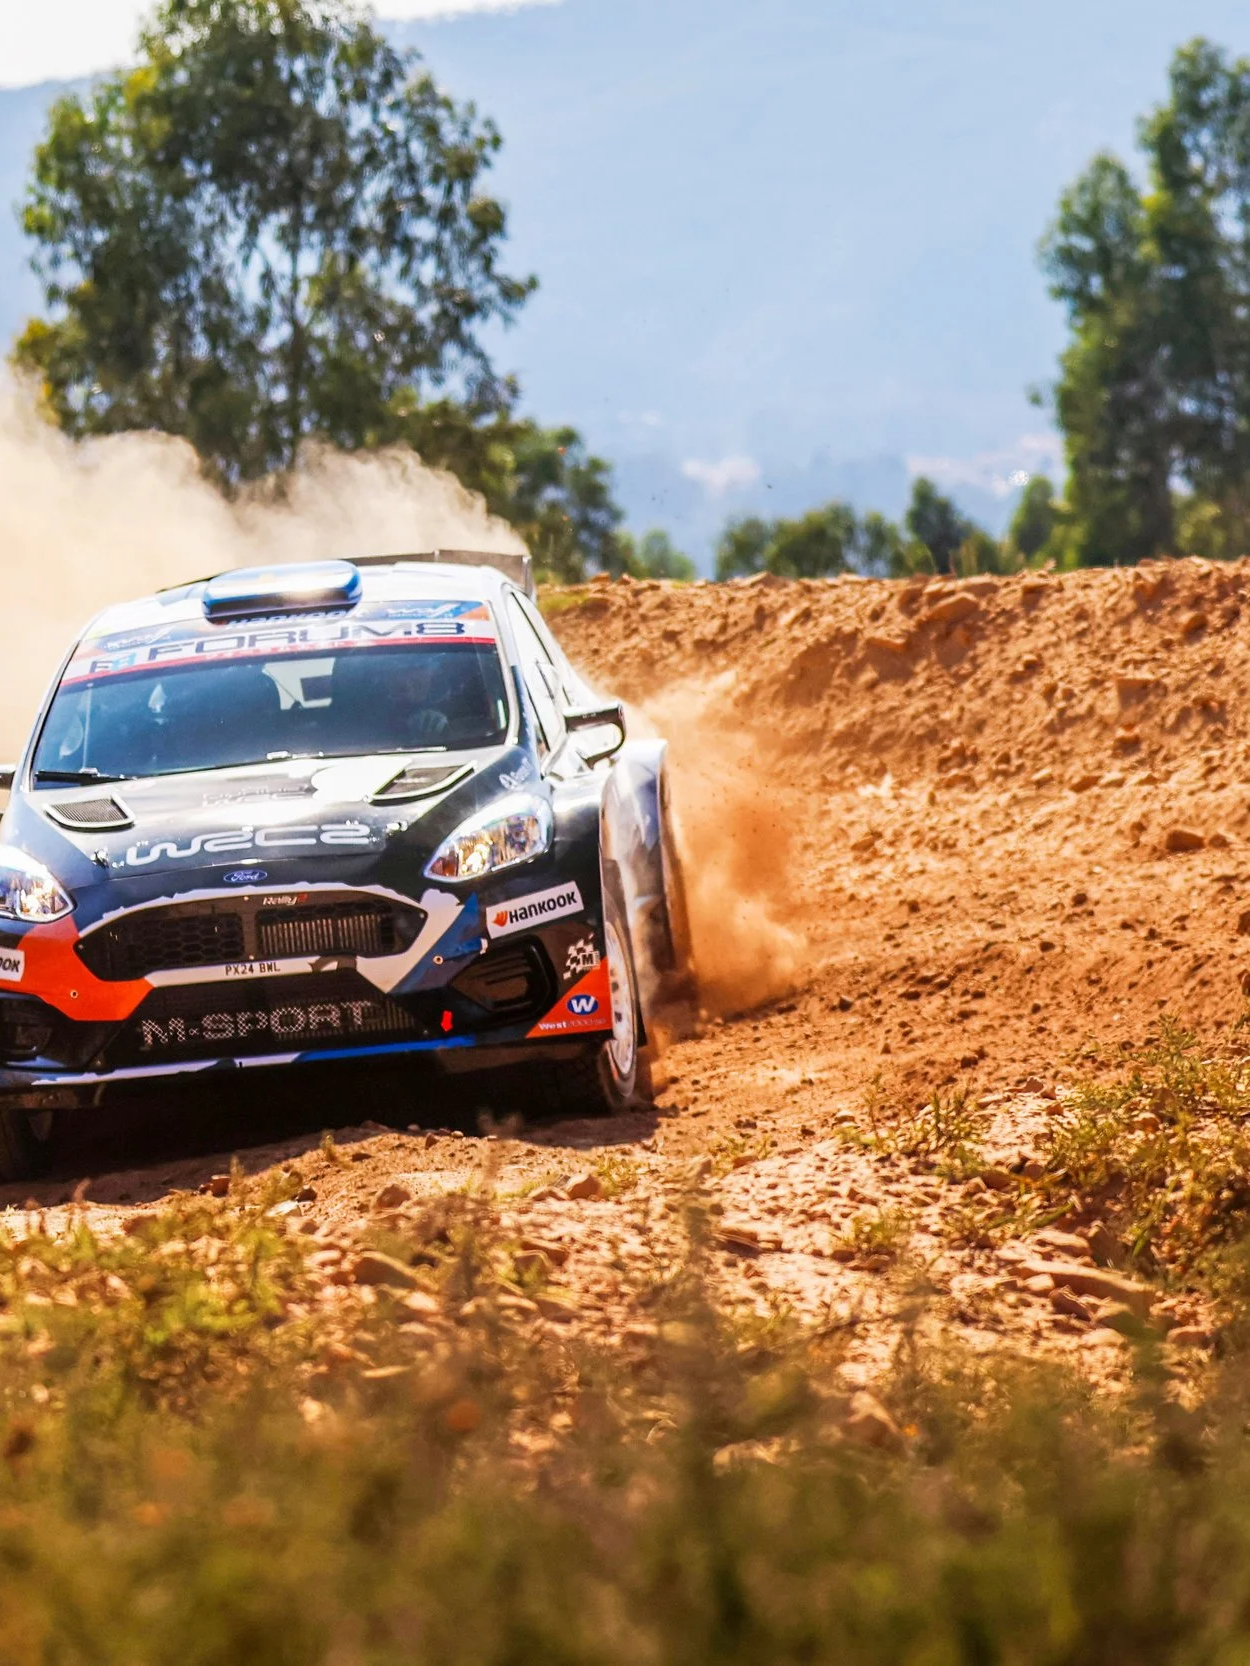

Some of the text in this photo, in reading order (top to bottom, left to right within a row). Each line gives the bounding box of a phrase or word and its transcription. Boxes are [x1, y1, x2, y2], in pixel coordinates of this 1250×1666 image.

[148, 622, 465, 661] FORUM8
[230, 870, 262, 883] Ford
[225, 961, 281, 976] PX24 BWL
[571, 996, 596, 1014] W
